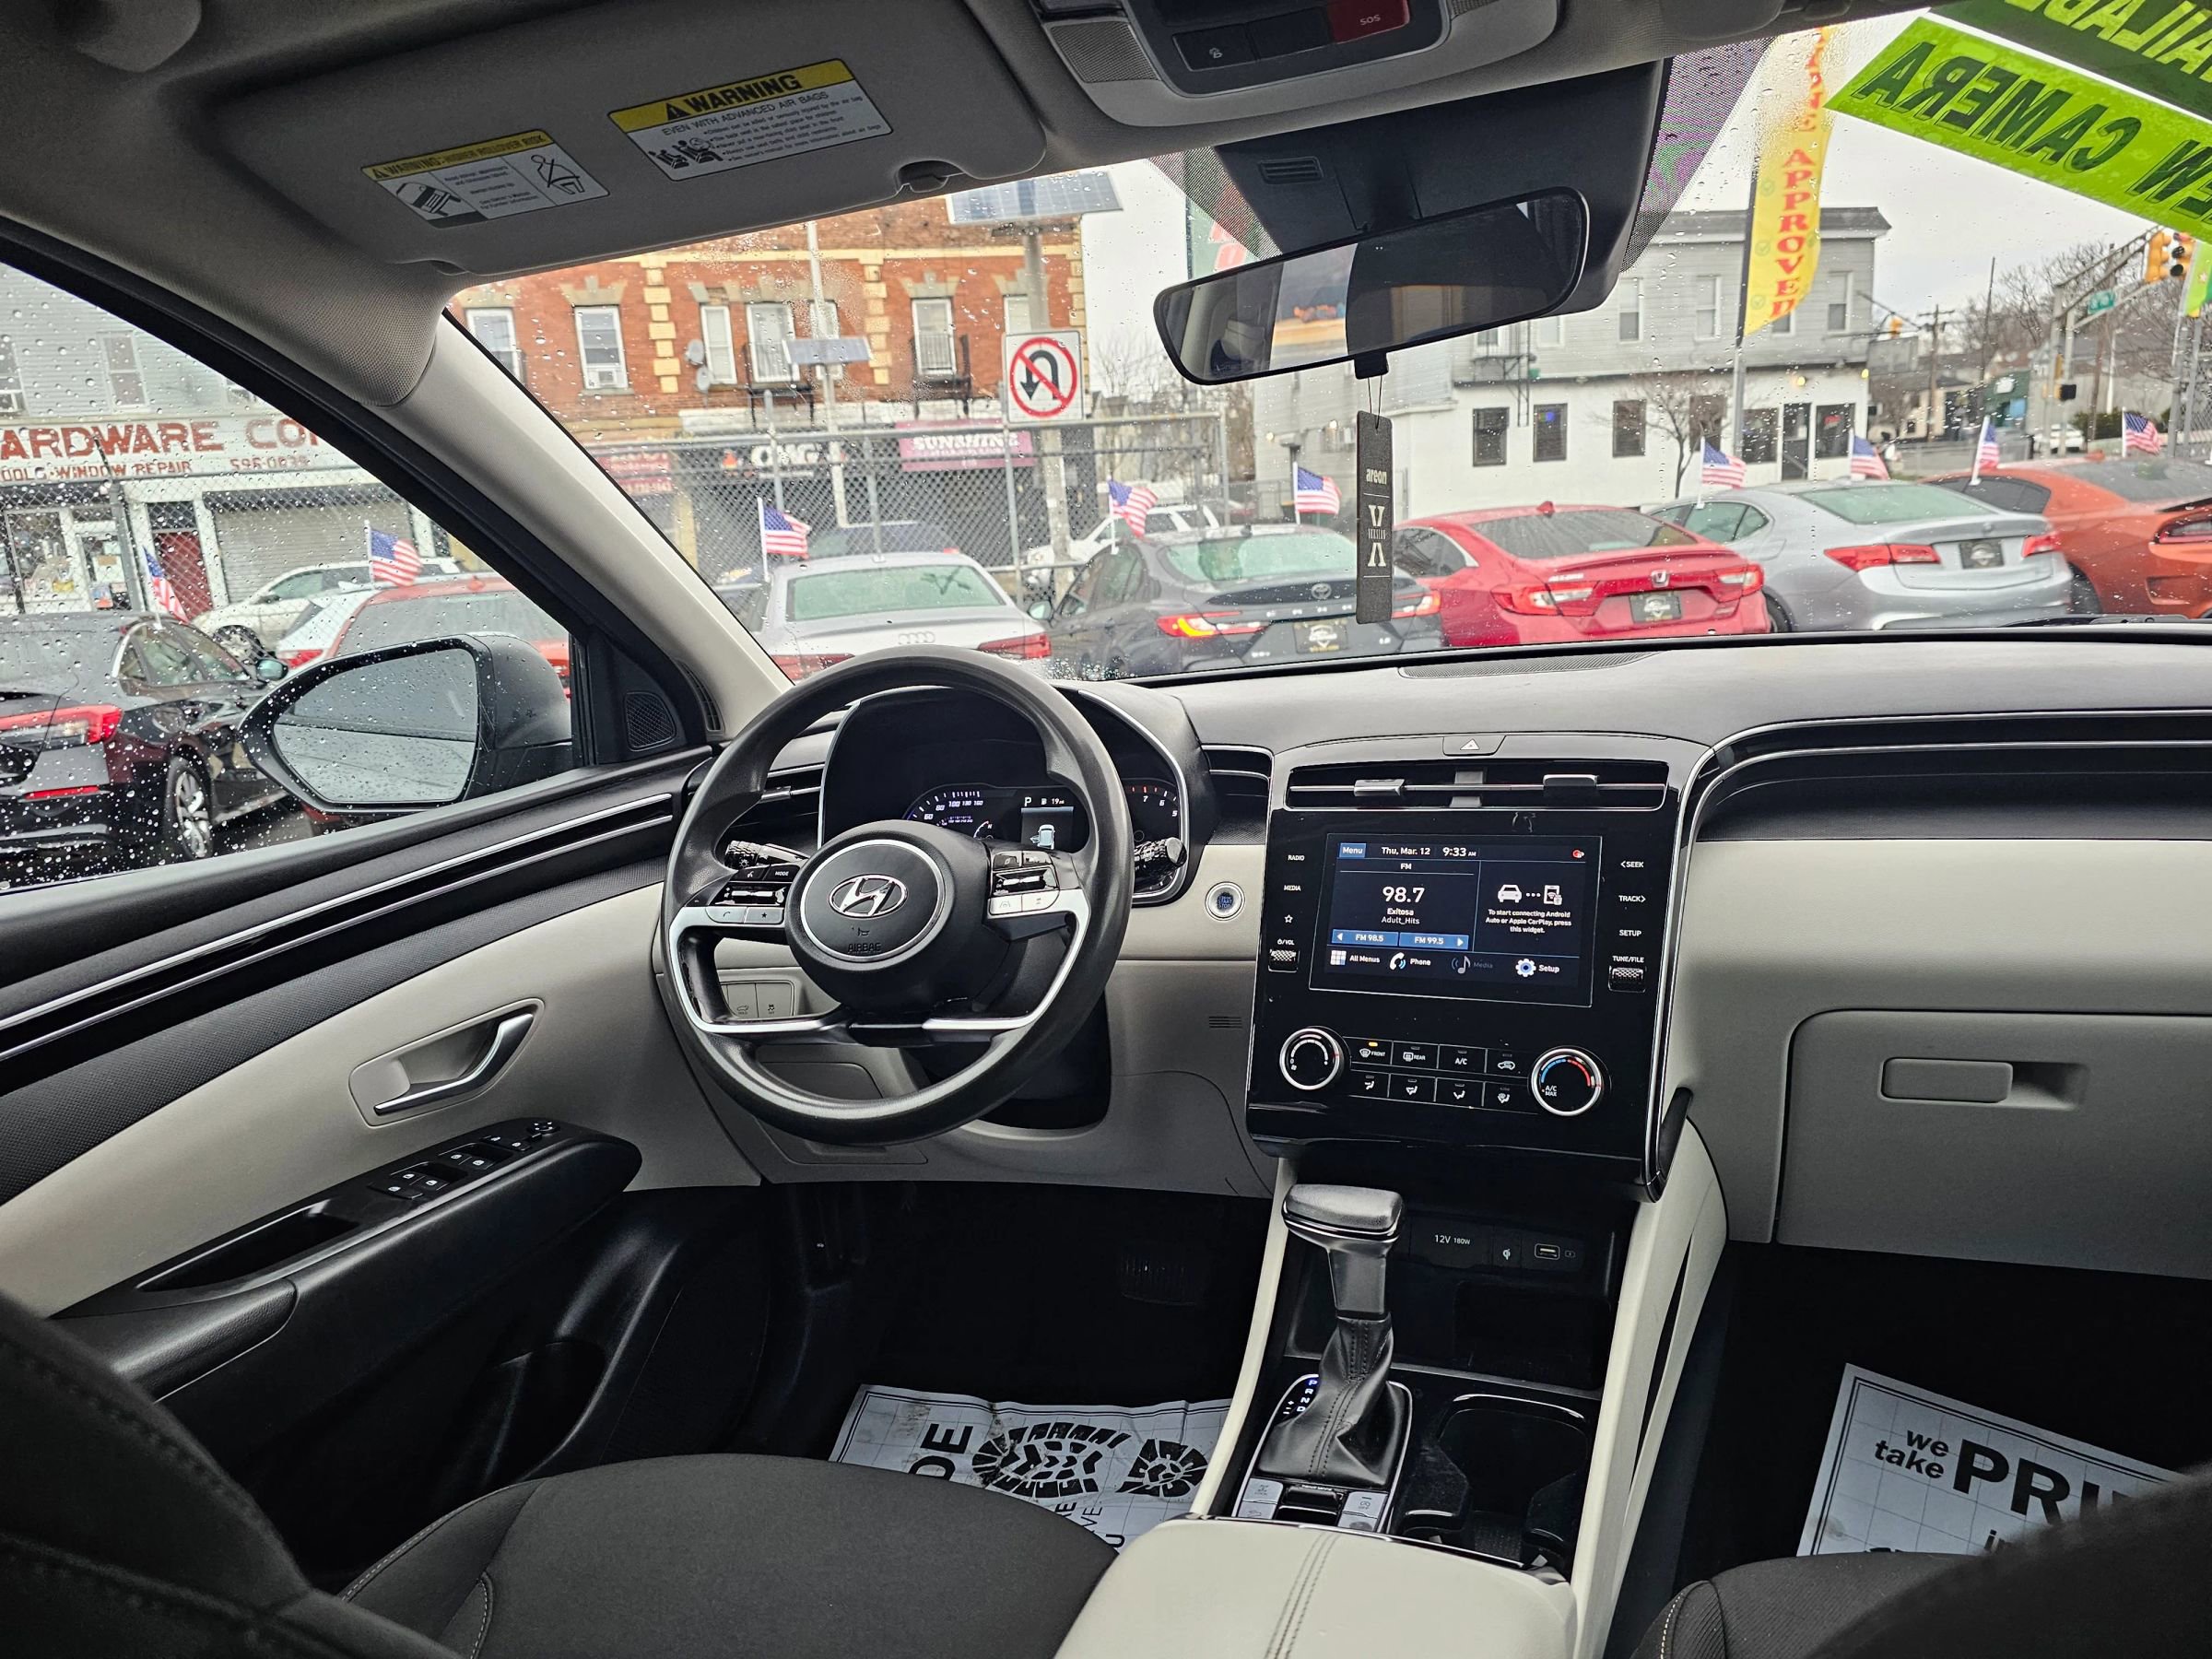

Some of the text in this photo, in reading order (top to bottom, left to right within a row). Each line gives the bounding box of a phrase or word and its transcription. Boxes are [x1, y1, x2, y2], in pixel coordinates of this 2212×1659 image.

[1359, 14, 1381, 26] SOS
[684, 74, 803, 113] WARNING
[660, 91, 830, 135] EVEN WITH ADVANCED AIR BAGS
[1769, 148, 1815, 318] APPROVED
[245, 418, 320, 449] CO
[132, 461, 192, 476] REPAIR
[1366, 468, 1387, 485] areon
[1024, 796, 1032, 807] P
[1342, 846, 1363, 854] Menu
[1382, 846, 1399, 855] Thu,
[1401, 846, 1418, 855] Mar.
[1420, 847, 1430, 855] 12
[1442, 847, 1466, 857] 9:33
[1382, 886, 1426, 903] 98.7
[1387, 907, 1415, 916] Exitosa
[1512, 910, 1546, 918] connecting
[1382, 916, 1420, 924] Adult_Hits
[1523, 926, 1546, 935] widget.
[1618, 929, 1641, 937] SETUP
[1428, 936, 1444, 945] 99.5
[1410, 958, 1431, 966] Phone
[1612, 955, 1645, 963] TUNE/FILE
[1538, 964, 1560, 973] Setup
[1454, 1057, 1468, 1065] A/C
[1435, 1234, 1471, 1245] 12V 180W
[1905, 1429, 1949, 1458] we
[1873, 1440, 1945, 1479] take
